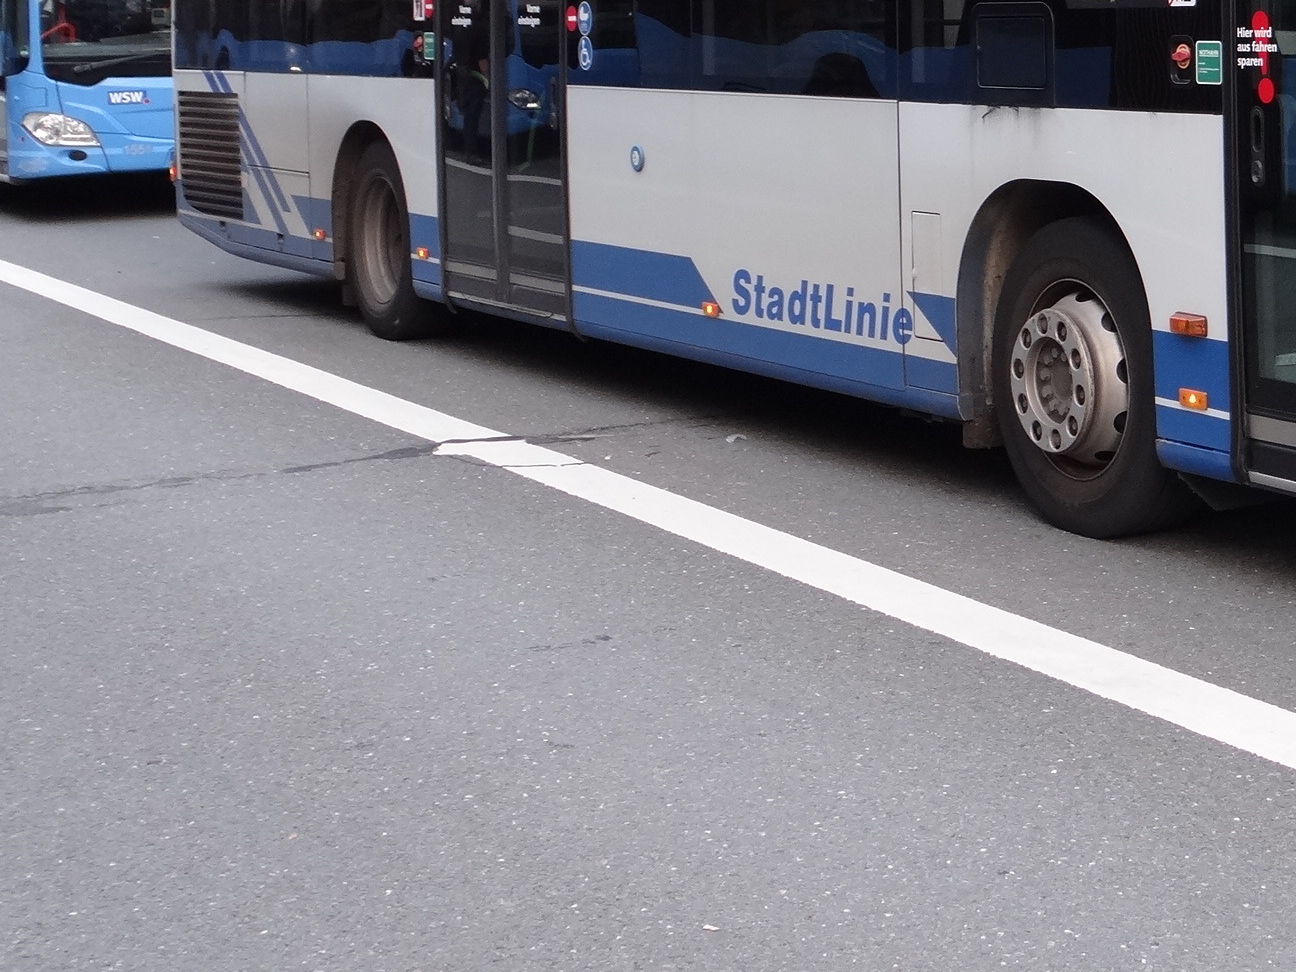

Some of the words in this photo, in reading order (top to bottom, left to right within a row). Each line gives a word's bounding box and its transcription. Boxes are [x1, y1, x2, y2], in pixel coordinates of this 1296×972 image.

[1237, 27, 1253, 38] Hier
[1254, 27, 1272, 38] wird
[1237, 43, 1251, 52] aus
[1252, 41, 1277, 53] fahren
[1238, 58, 1263, 69] sparen
[732, 269, 913, 345] StadtLinie
